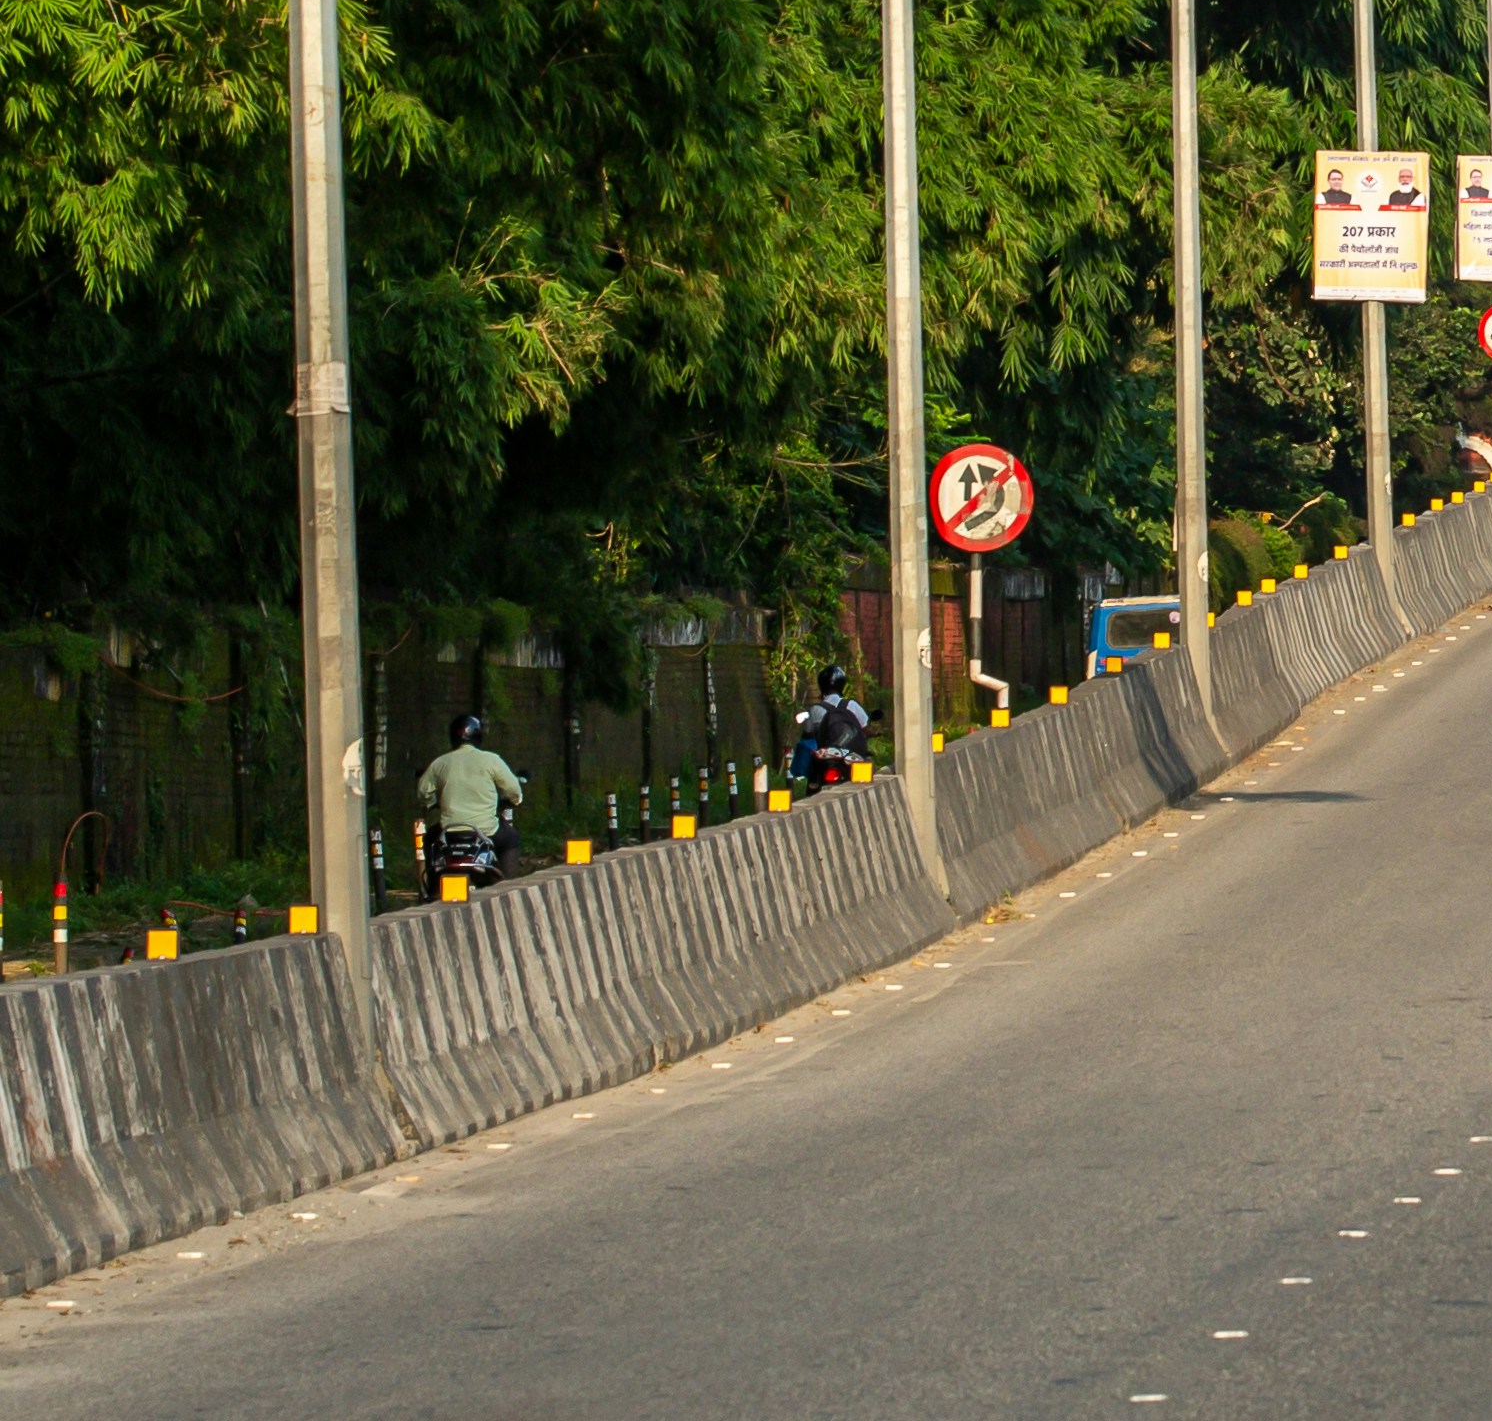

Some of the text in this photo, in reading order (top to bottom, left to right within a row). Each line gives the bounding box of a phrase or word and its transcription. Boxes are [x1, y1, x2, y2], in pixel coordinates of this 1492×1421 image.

[1342, 226, 1396, 238] 207 प्रकार
[1338, 243, 1349, 254] की
